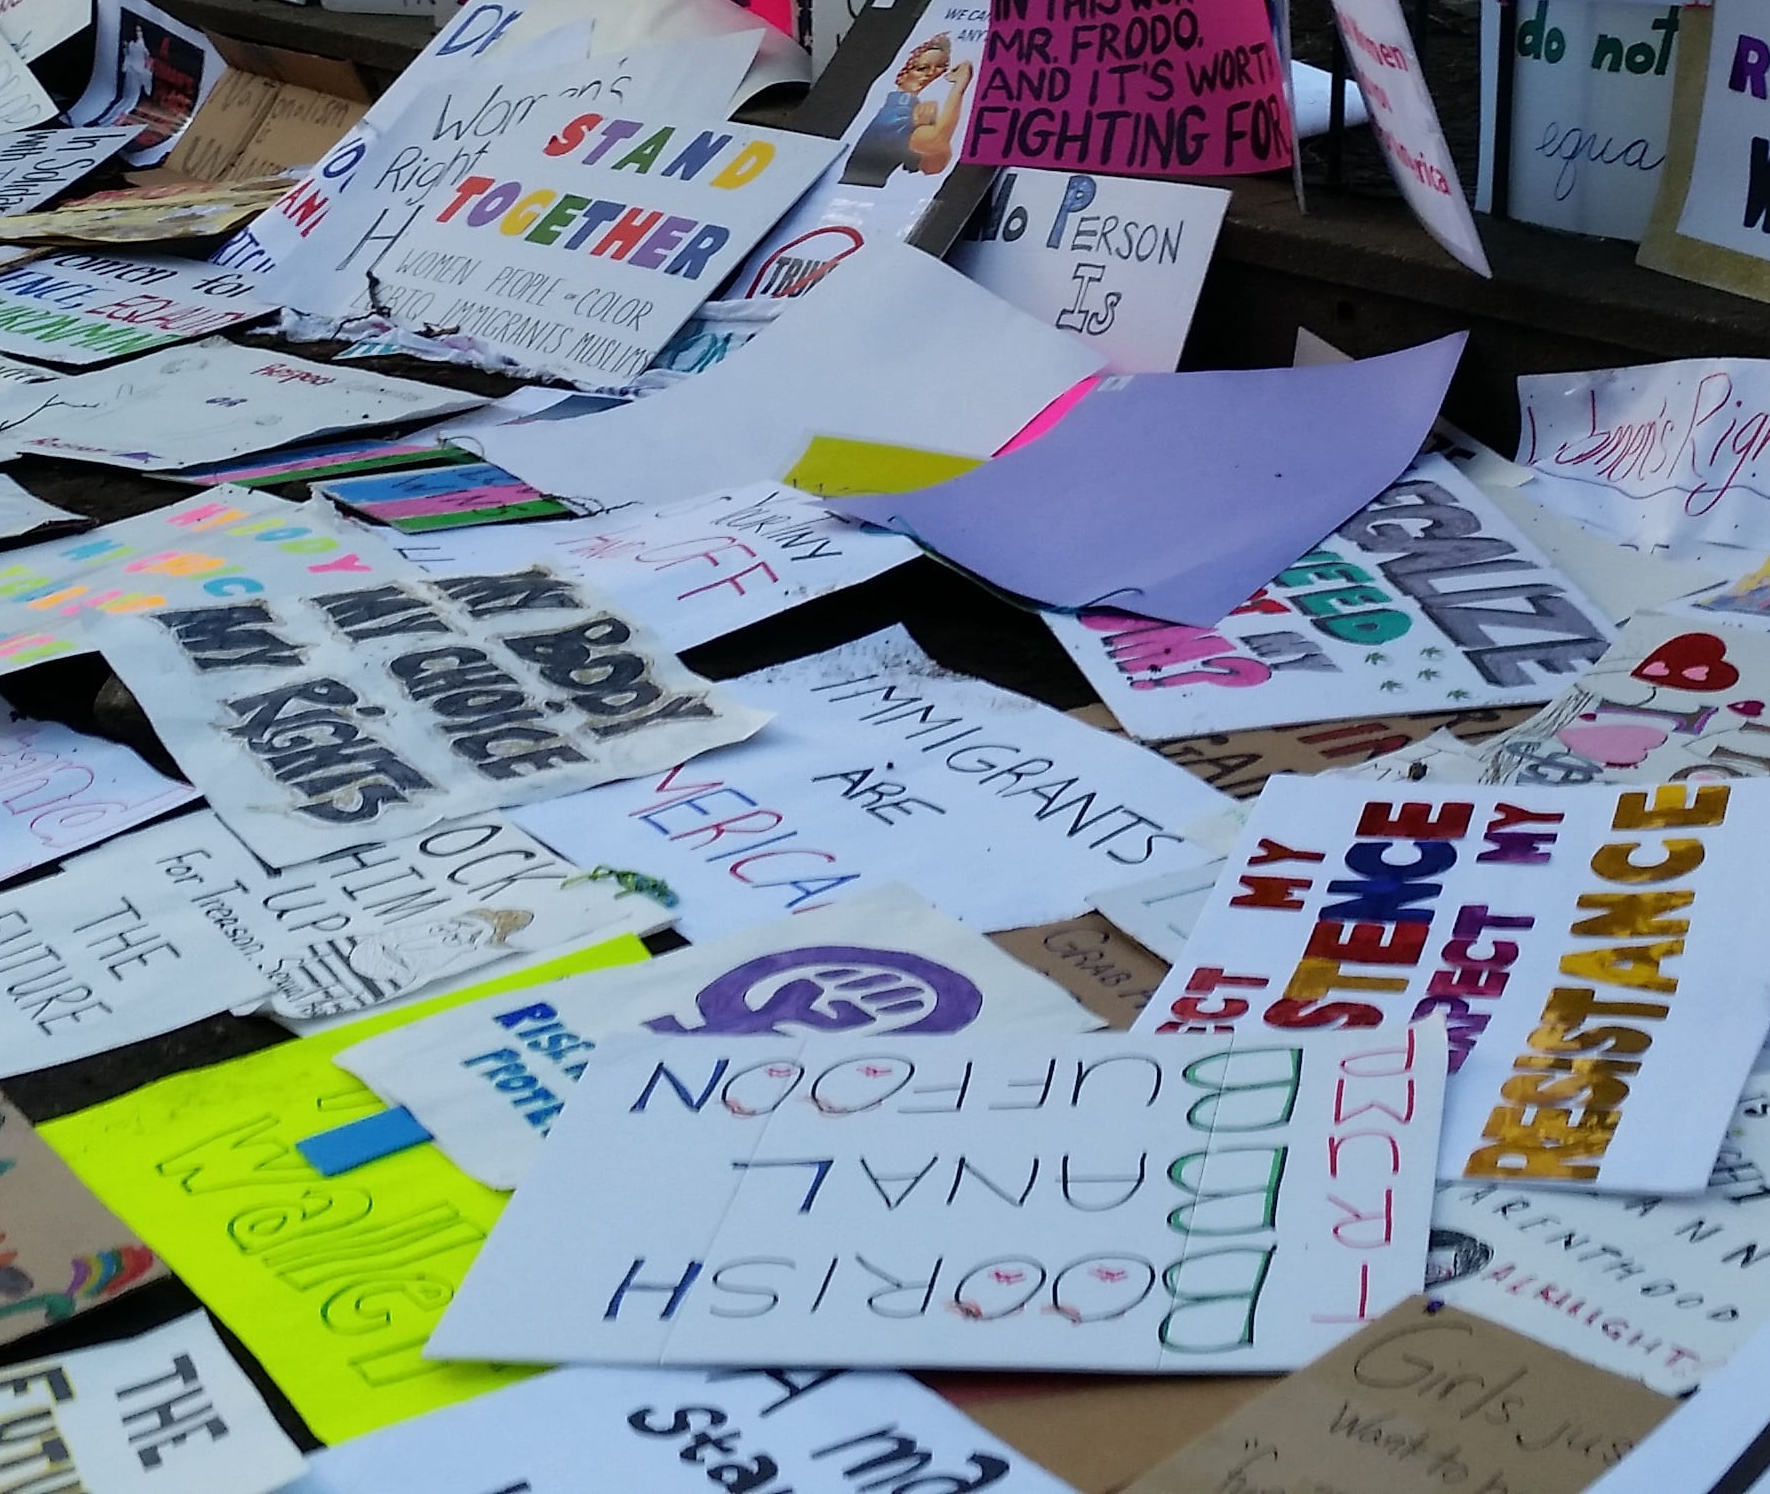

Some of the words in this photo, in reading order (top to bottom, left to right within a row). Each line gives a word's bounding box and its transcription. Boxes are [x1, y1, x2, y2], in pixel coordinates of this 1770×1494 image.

[984, 26, 1063, 68] MR.
[1517, 0, 1565, 65] do
[1592, 14, 1679, 78] not
[979, 61, 1077, 103] AND
[1087, 59, 1174, 105] IT'S
[542, 112, 776, 191] STAND
[967, 105, 1209, 170] FIGHTING
[435, 175, 735, 283] TOGETHER
[395, 248, 481, 286] WOMEN
[485, 266, 566, 306] PEOPLE
[574, 288, 653, 332] COLOR
[384, 645, 593, 779] CHOICE
[811, 673, 1184, 867] IMMIGRANTS
[811, 759, 945, 827] ARE
[1228, 838, 1326, 911] MY
[114, 1353, 232, 1474] THE
